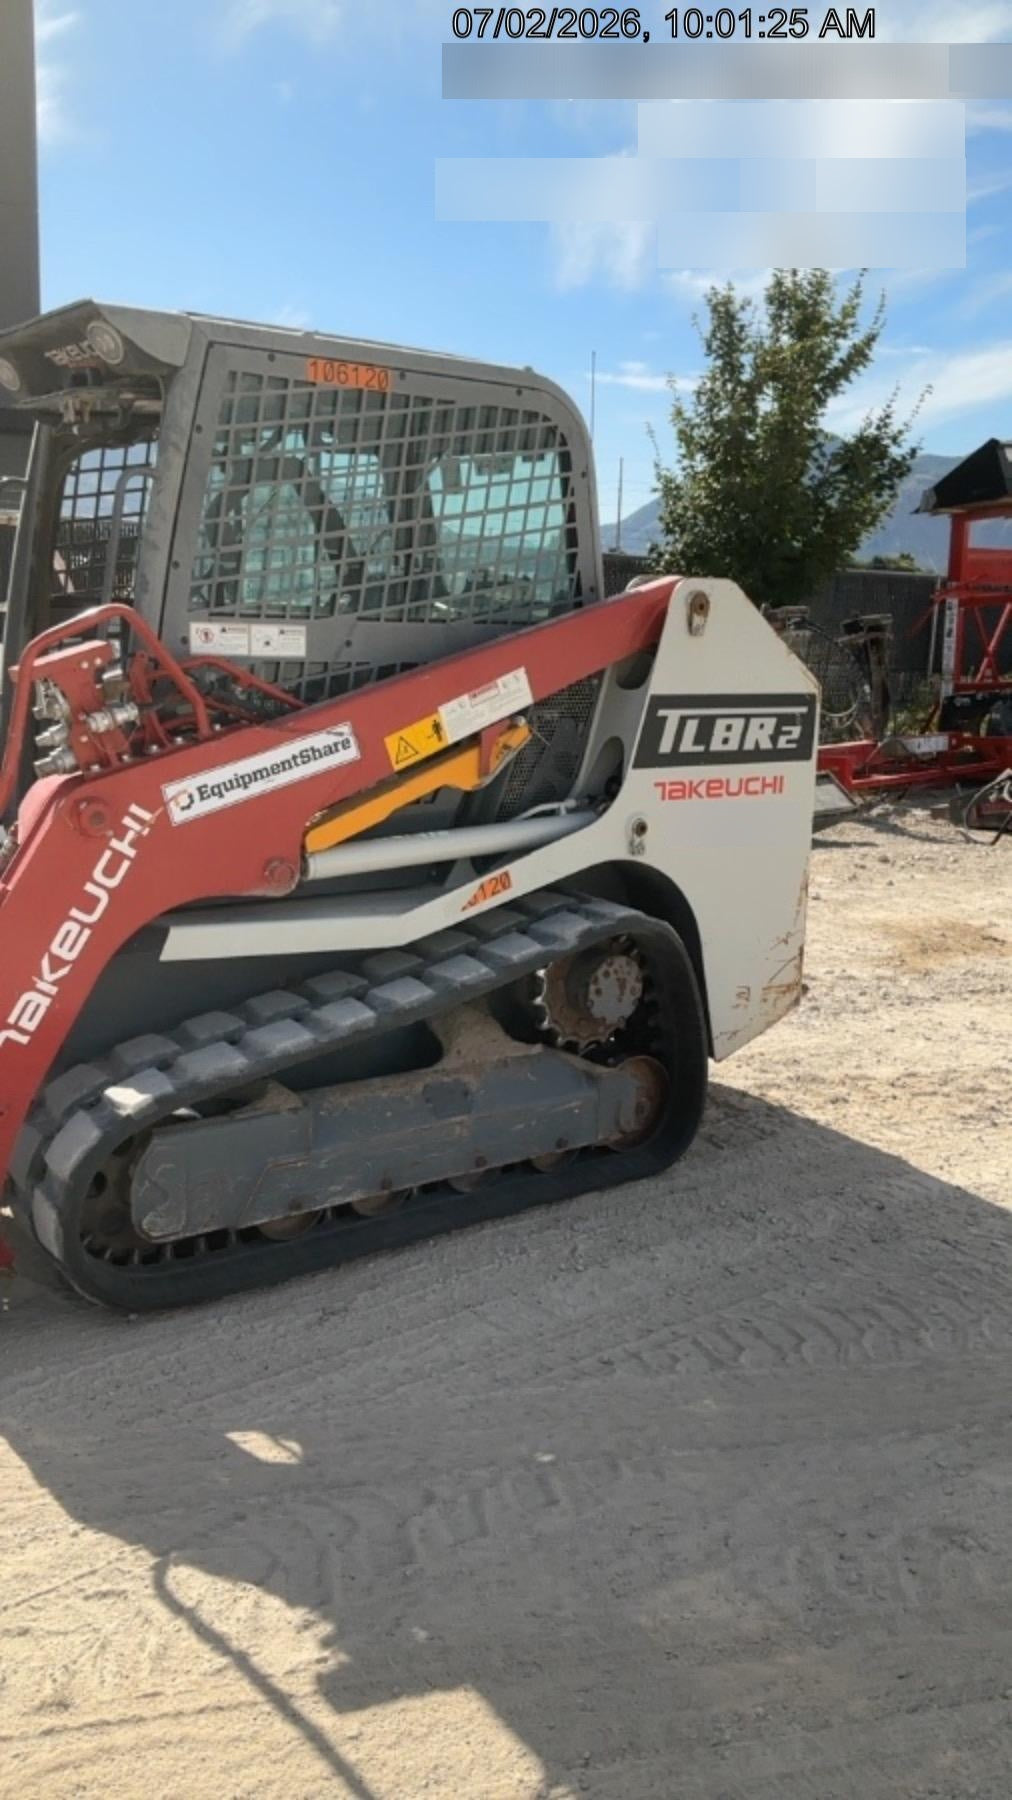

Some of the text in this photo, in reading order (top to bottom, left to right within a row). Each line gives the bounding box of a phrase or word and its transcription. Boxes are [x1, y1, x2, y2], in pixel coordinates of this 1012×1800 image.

[309, 359, 390, 391] 106120
[655, 706, 809, 755] TL8R2
[196, 736, 352, 802] EquipmentShare
